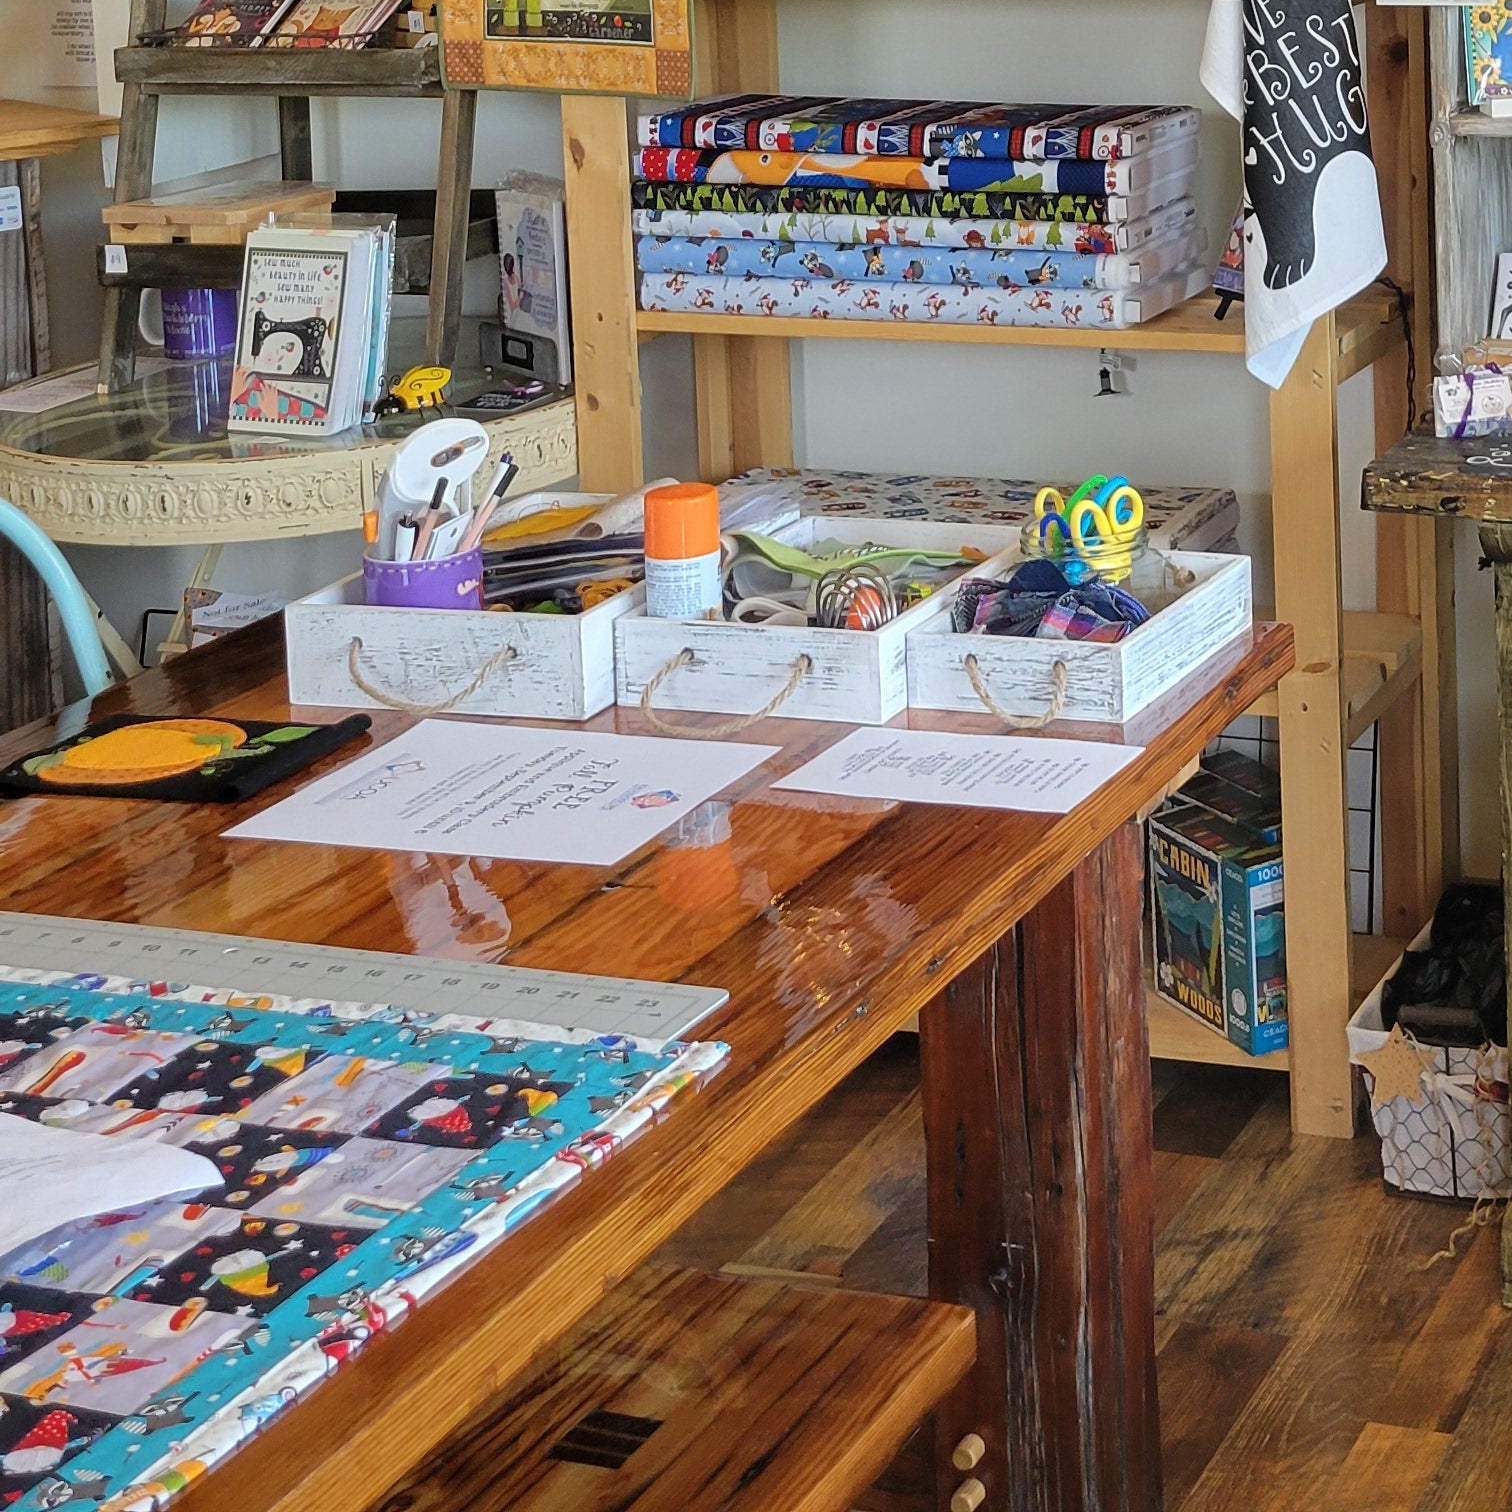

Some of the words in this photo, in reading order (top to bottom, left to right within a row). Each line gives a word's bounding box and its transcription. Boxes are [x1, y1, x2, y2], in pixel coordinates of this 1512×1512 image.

[1248, 13, 1359, 105] BEST
[553, 780, 619, 809] FREE
[1159, 838, 1211, 888] CABIN
[635, 999, 660, 1007] 23
[1177, 979, 1222, 1025] WOODS
